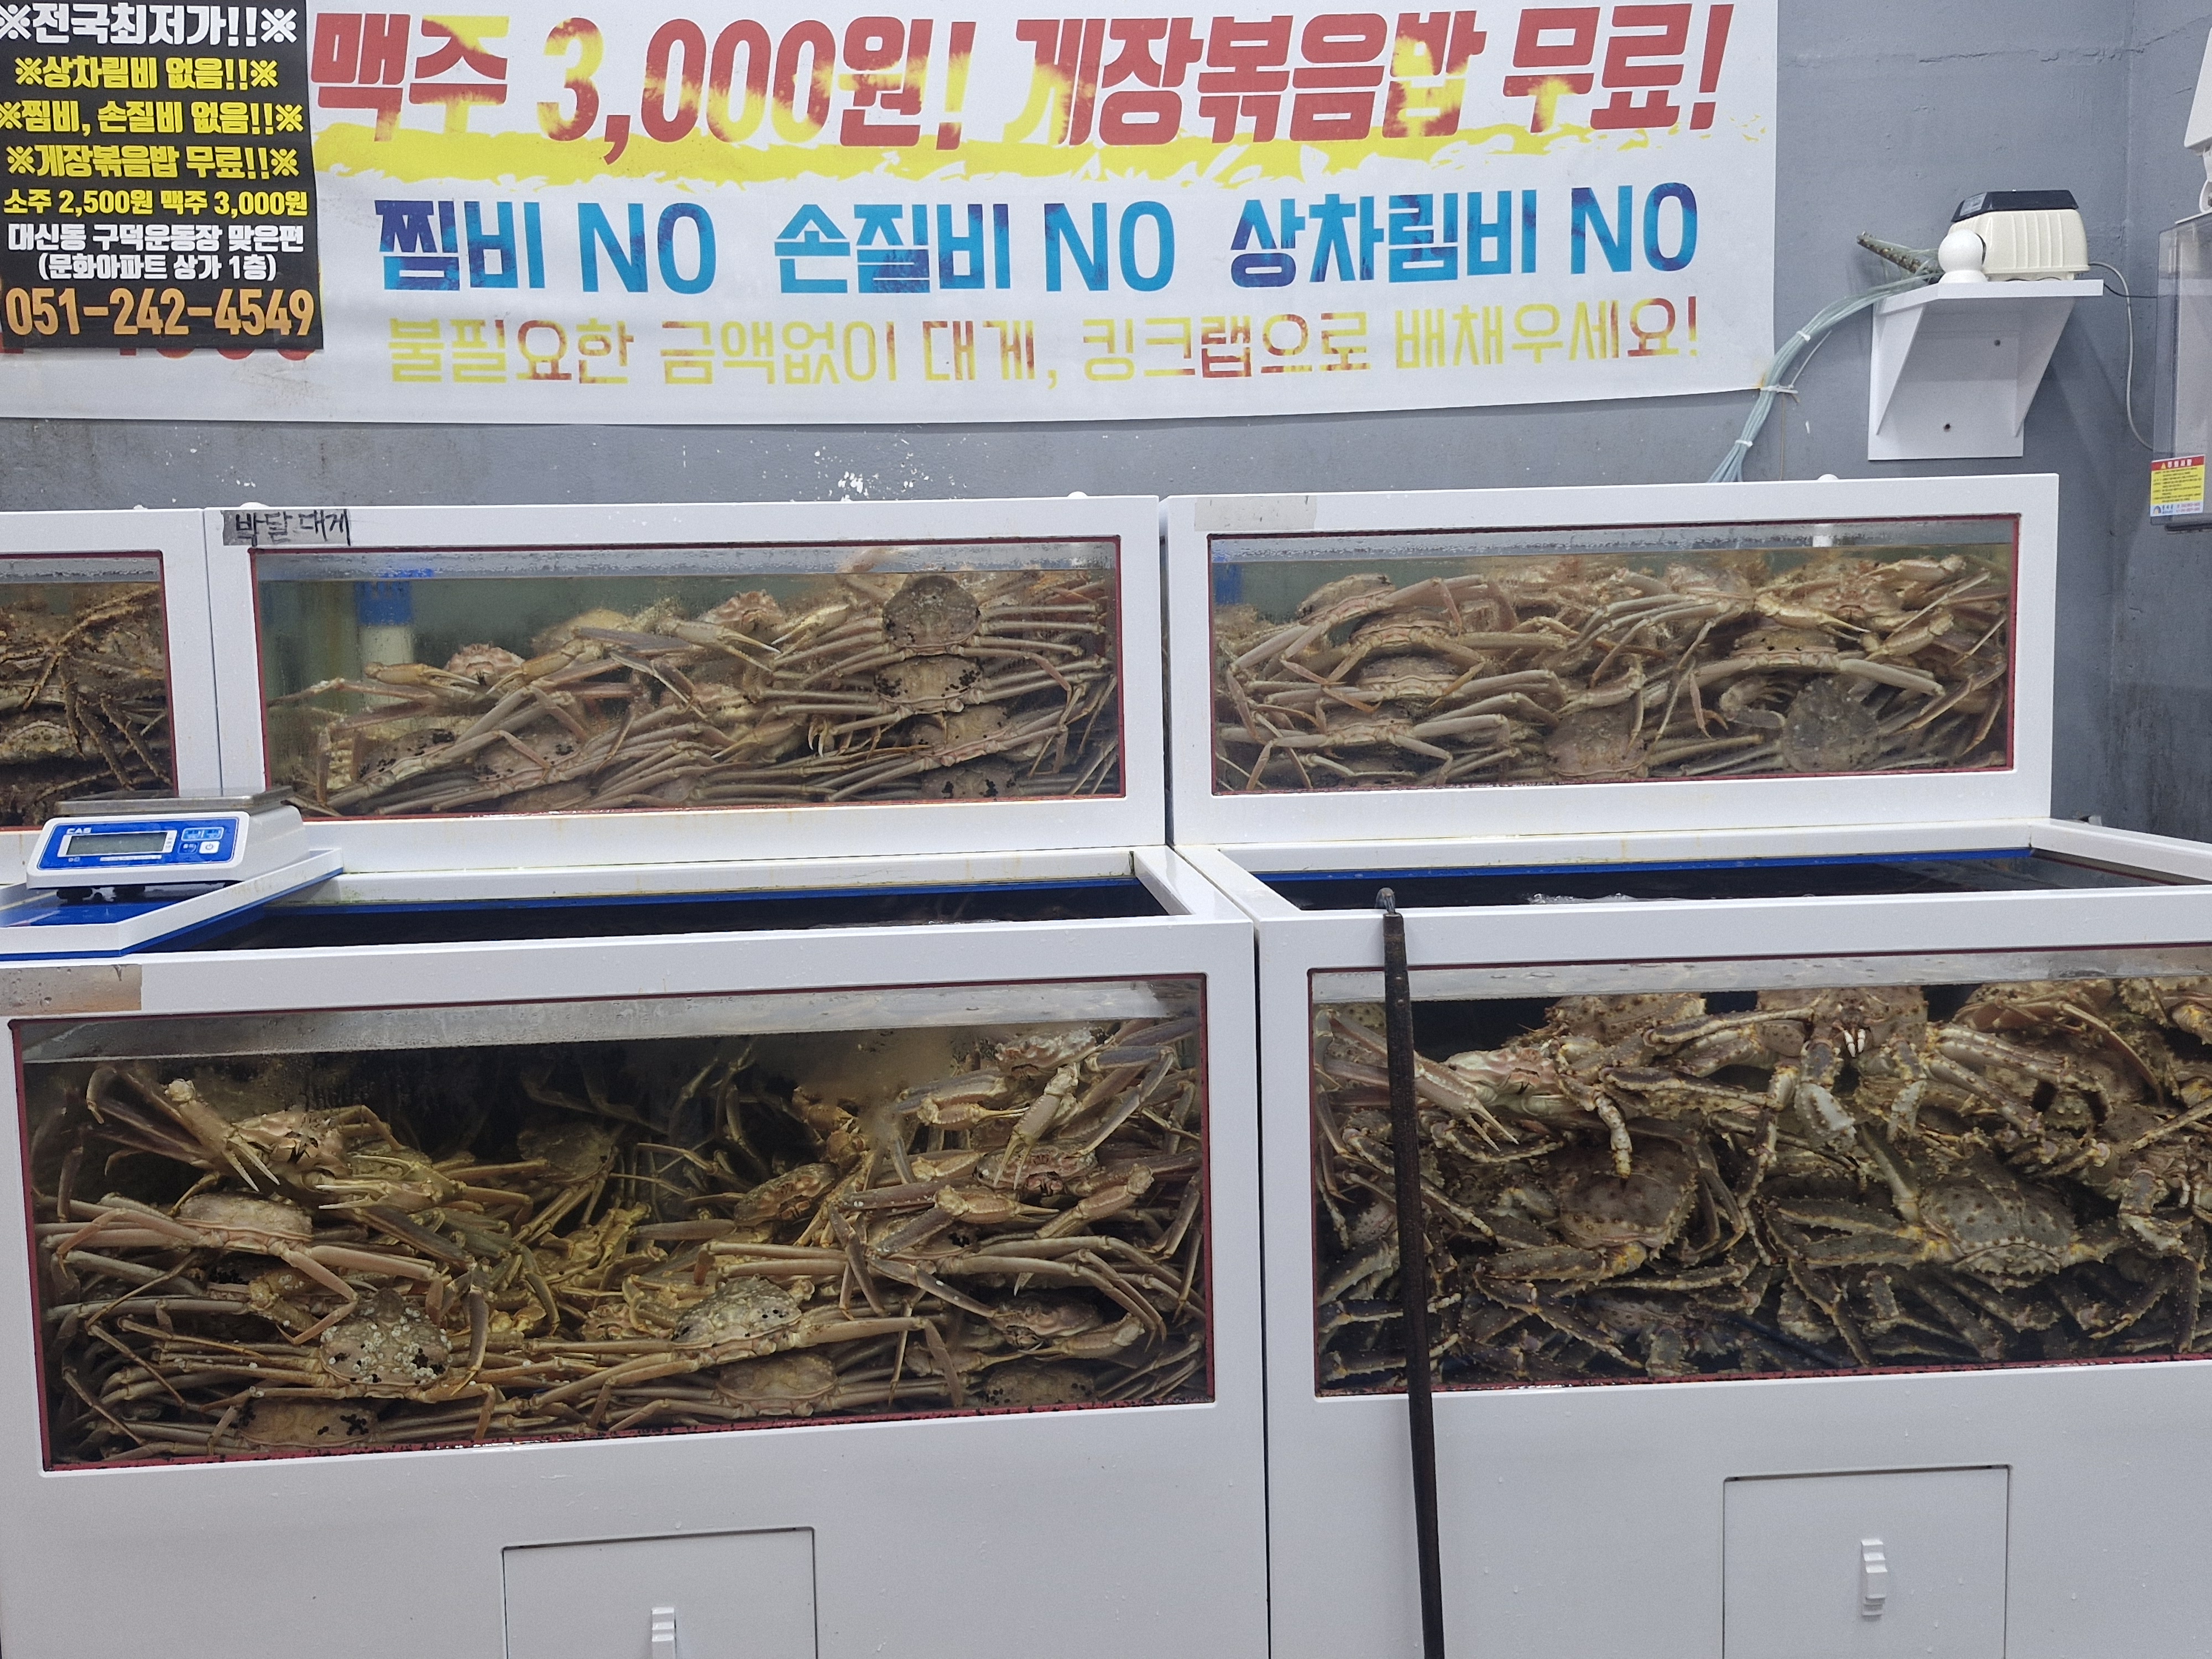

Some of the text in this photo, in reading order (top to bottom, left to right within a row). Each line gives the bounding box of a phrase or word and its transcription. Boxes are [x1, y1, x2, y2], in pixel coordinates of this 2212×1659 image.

[311, 3, 1734, 165] 맥주 3,000원! 게장볶음밥 무료!
[98, 101, 184, 133] 손질비
[4, 190, 308, 218] 소주 2,500원 맥주 3,000원
[8, 223, 304, 252] 대신동 구덕운동장 맞은편
[374, 182, 1698, 295] 찜비 NO 손질비 NO 상차림비 NO
[38, 254, 276, 280] (문화아파트 상가 1층)
[5, 287, 314, 336] 051-242-4549
[388, 296, 1697, 389] 불필요한 금액없이 대게, 킹크랩으로 배채우세요!
